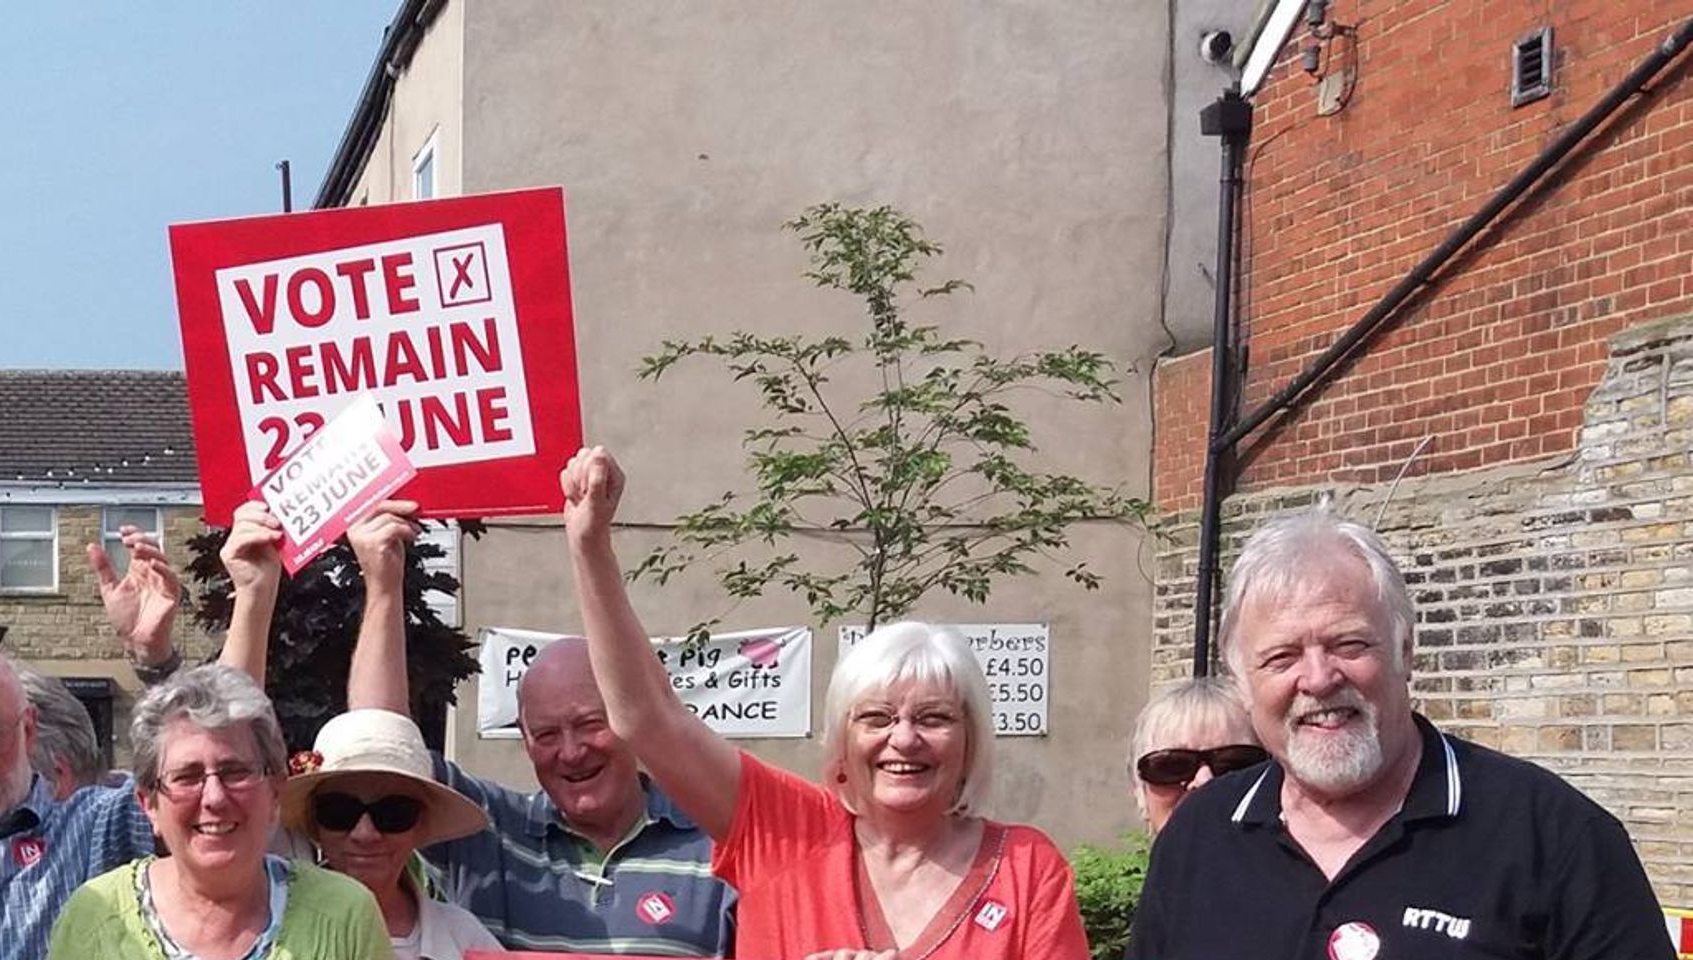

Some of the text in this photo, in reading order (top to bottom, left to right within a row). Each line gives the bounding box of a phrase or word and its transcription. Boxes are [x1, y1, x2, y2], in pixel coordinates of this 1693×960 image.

[234, 253, 420, 335] VOTE
[245, 318, 502, 405] REMAIN
[397, 387, 512, 453] JUNE
[269, 437, 324, 495] VOT
[292, 505, 320, 536] 23
[324, 453, 381, 511] JUNE
[704, 671, 718, 689] &
[728, 670, 781, 689] Gifts
[986, 658, 1044, 676] £4.50
[685, 701, 777, 720] ANCE
[992, 712, 1041, 731] 3.50
